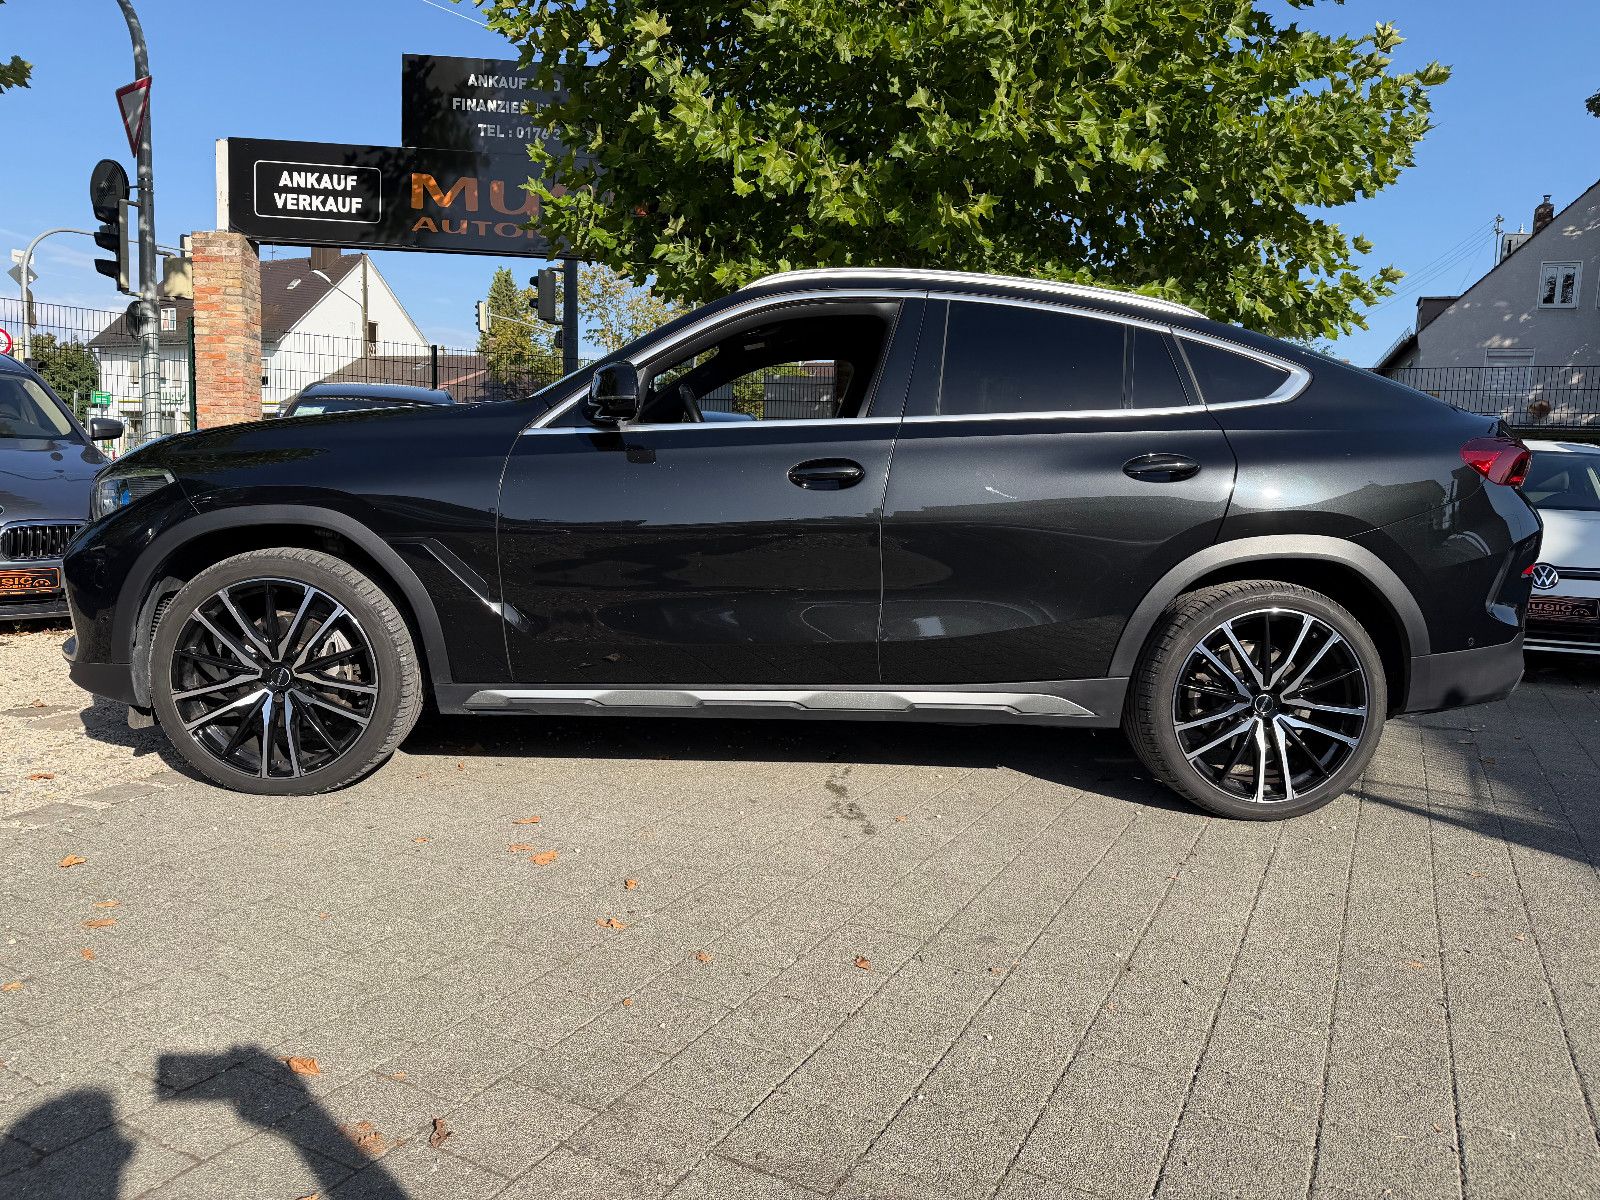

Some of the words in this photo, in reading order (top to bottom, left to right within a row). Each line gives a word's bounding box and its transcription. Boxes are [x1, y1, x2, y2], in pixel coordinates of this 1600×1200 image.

[467, 73, 527, 90] ANKAUF
[453, 97, 544, 115] FINANZIE
[478, 123, 505, 138] TEL
[278, 170, 358, 191] ANKAUF
[273, 192, 363, 214] VERKAUF
